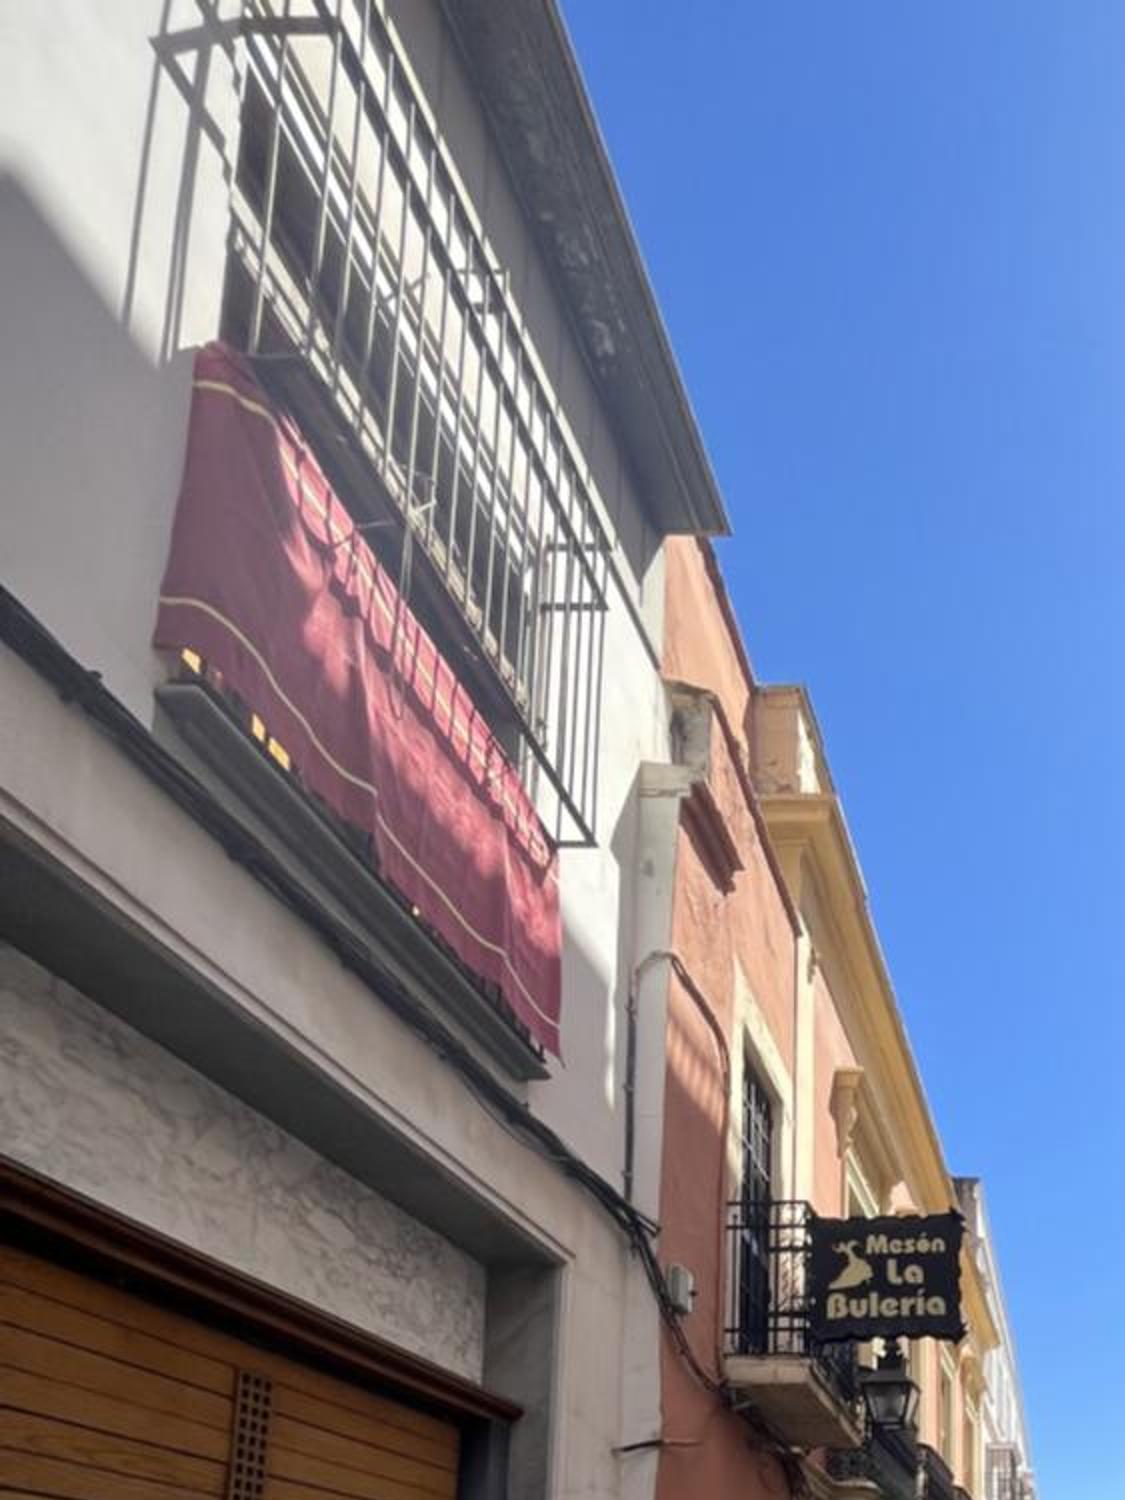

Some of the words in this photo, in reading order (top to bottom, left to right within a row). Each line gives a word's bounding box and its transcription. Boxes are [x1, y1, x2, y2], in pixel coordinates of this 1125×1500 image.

[866, 1232, 946, 1255] Mesón
[886, 1258, 925, 1285] La
[826, 1289, 946, 1319] Bulería
